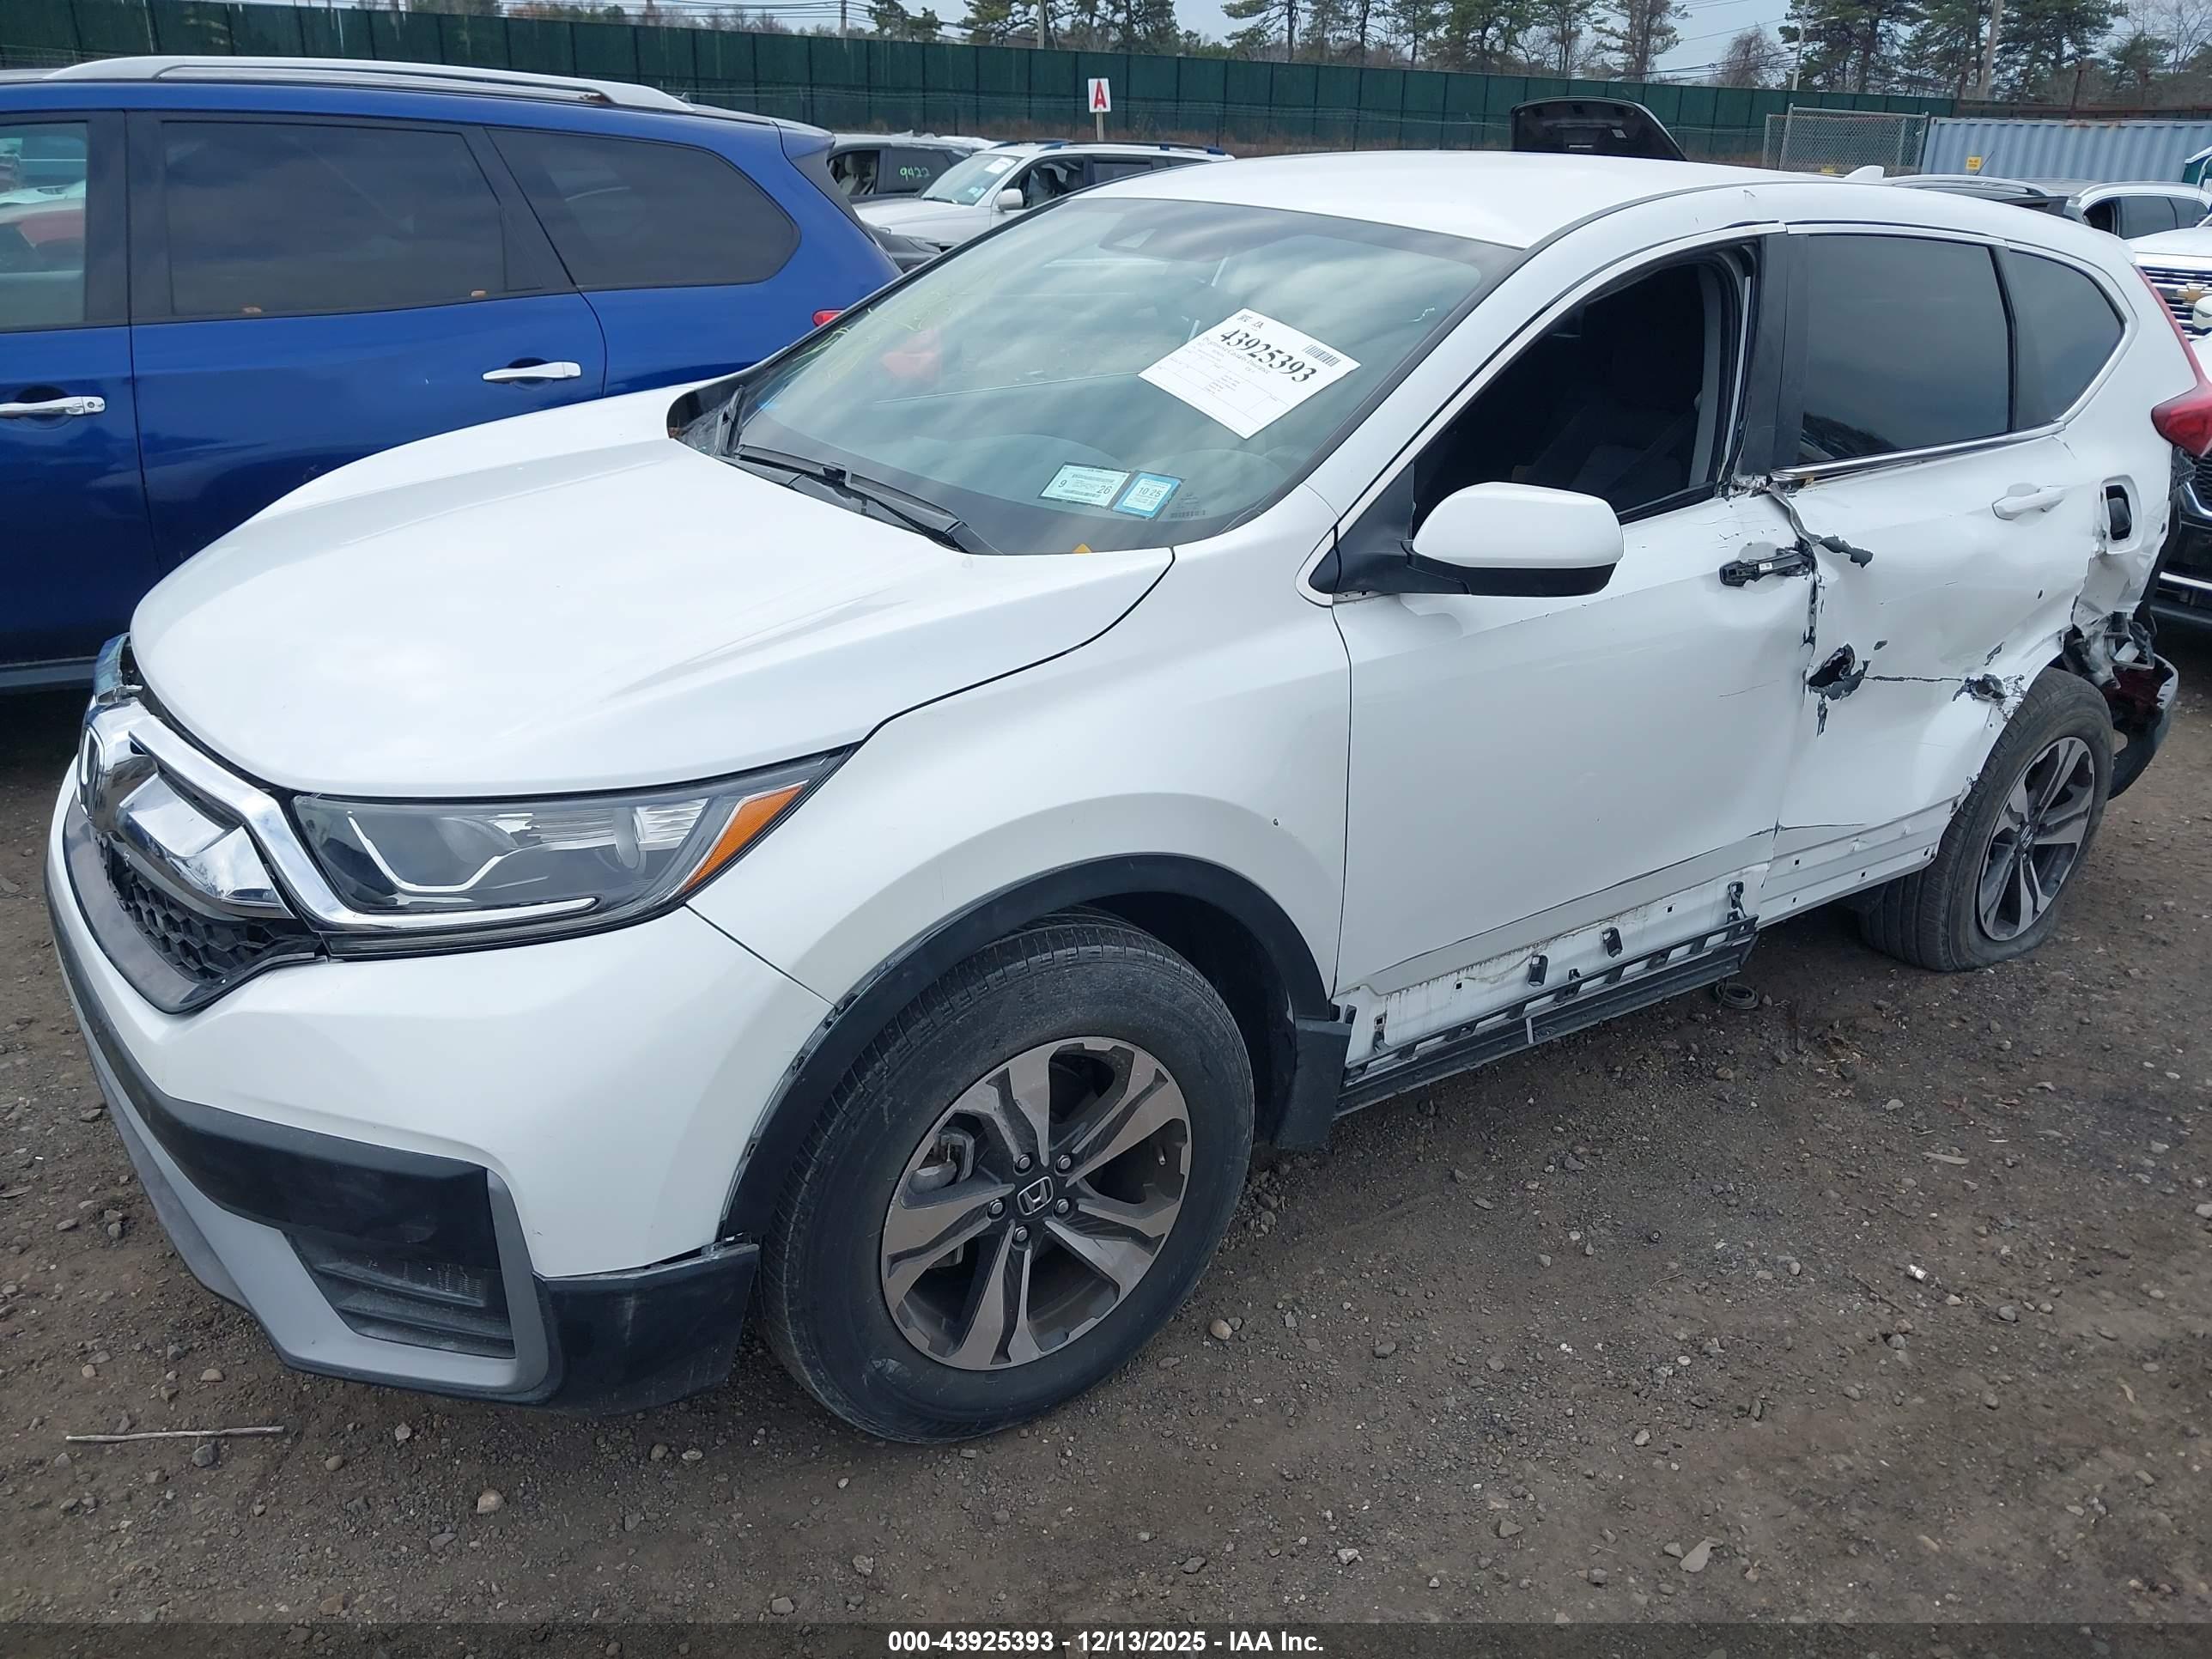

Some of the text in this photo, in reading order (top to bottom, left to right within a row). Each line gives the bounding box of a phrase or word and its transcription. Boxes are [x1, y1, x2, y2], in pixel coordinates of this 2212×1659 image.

[1093, 79, 1107, 109] A
[899, 167, 931, 181] 9422
[1219, 329, 1317, 383] 43925393
[1058, 479, 1067, 488] 9
[1097, 484, 1113, 495] 26
[1139, 486, 1162, 497] 10 25
